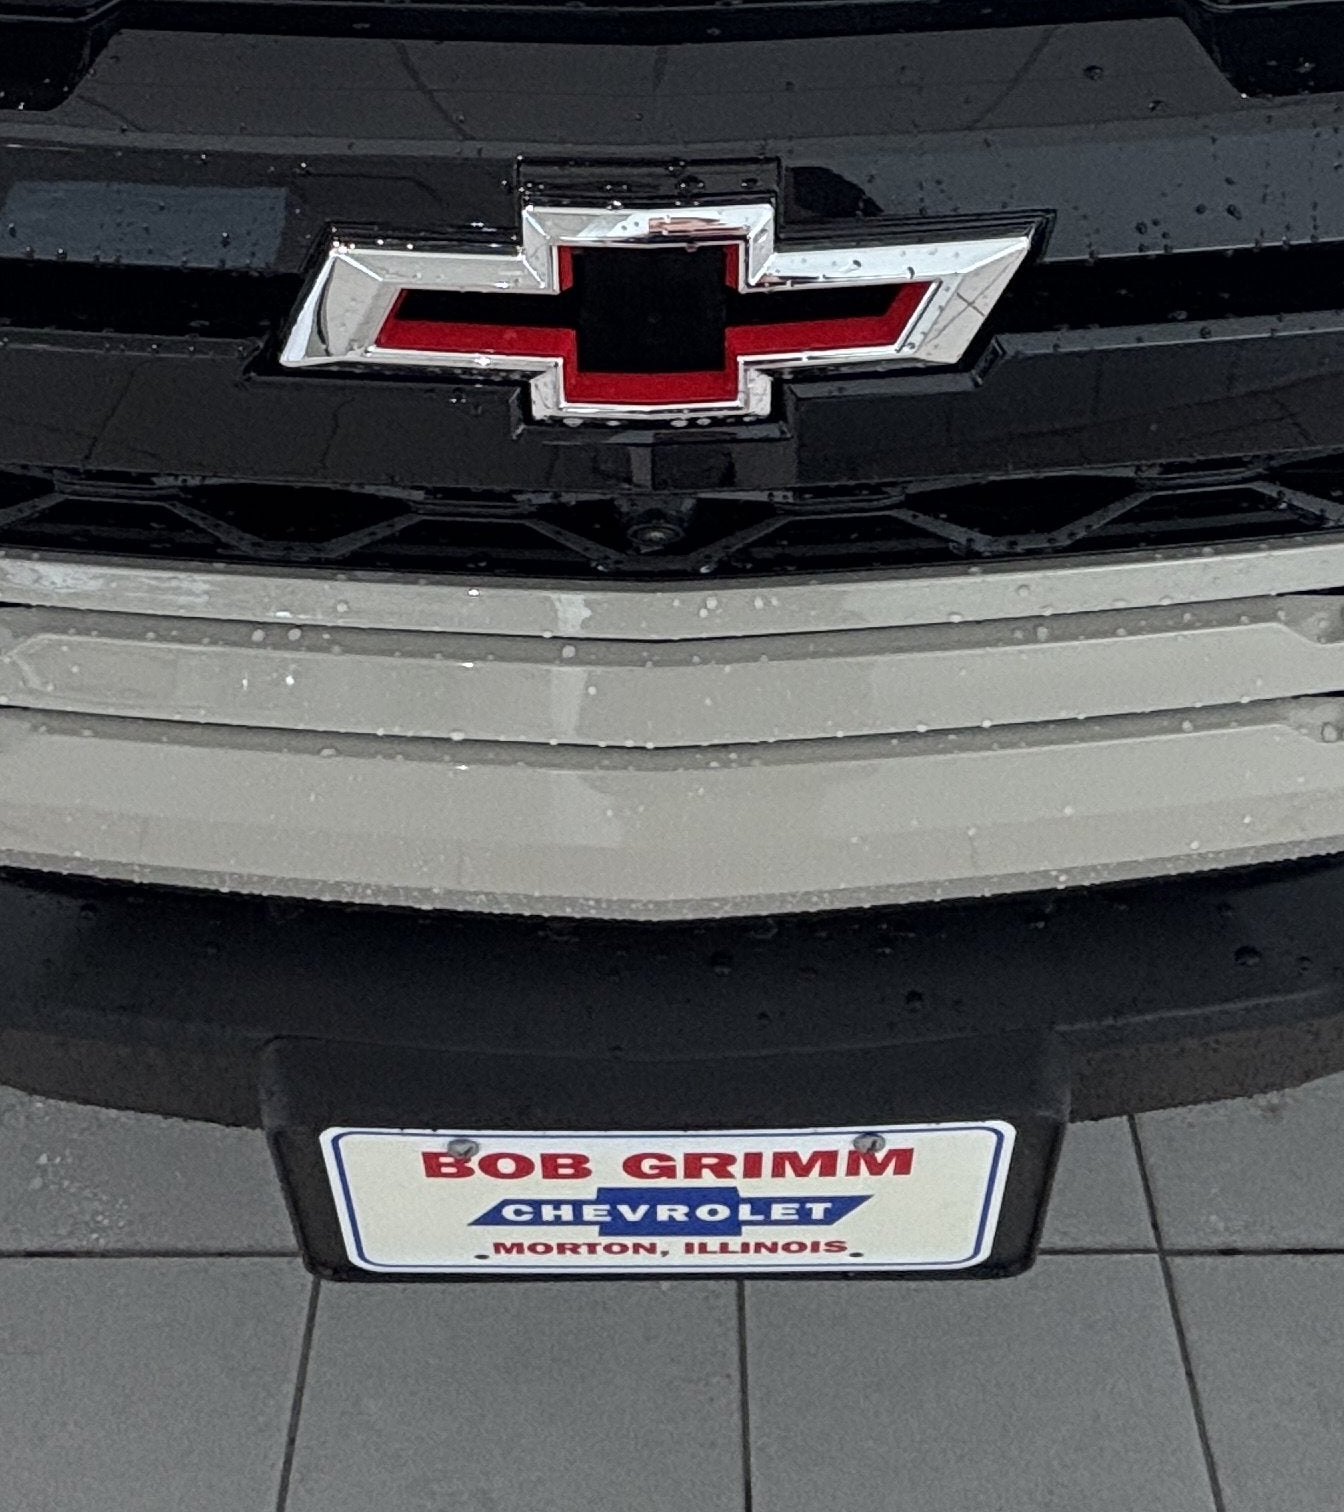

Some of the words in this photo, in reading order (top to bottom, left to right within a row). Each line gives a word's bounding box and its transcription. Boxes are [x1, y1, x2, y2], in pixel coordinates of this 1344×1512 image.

[422, 1152, 593, 1179] BOB
[622, 1148, 914, 1179] GRIMM
[501, 1202, 833, 1222] CHEVROLET
[493, 1241, 670, 1257] MORTON,
[685, 1241, 848, 1255] ILLINOIS
